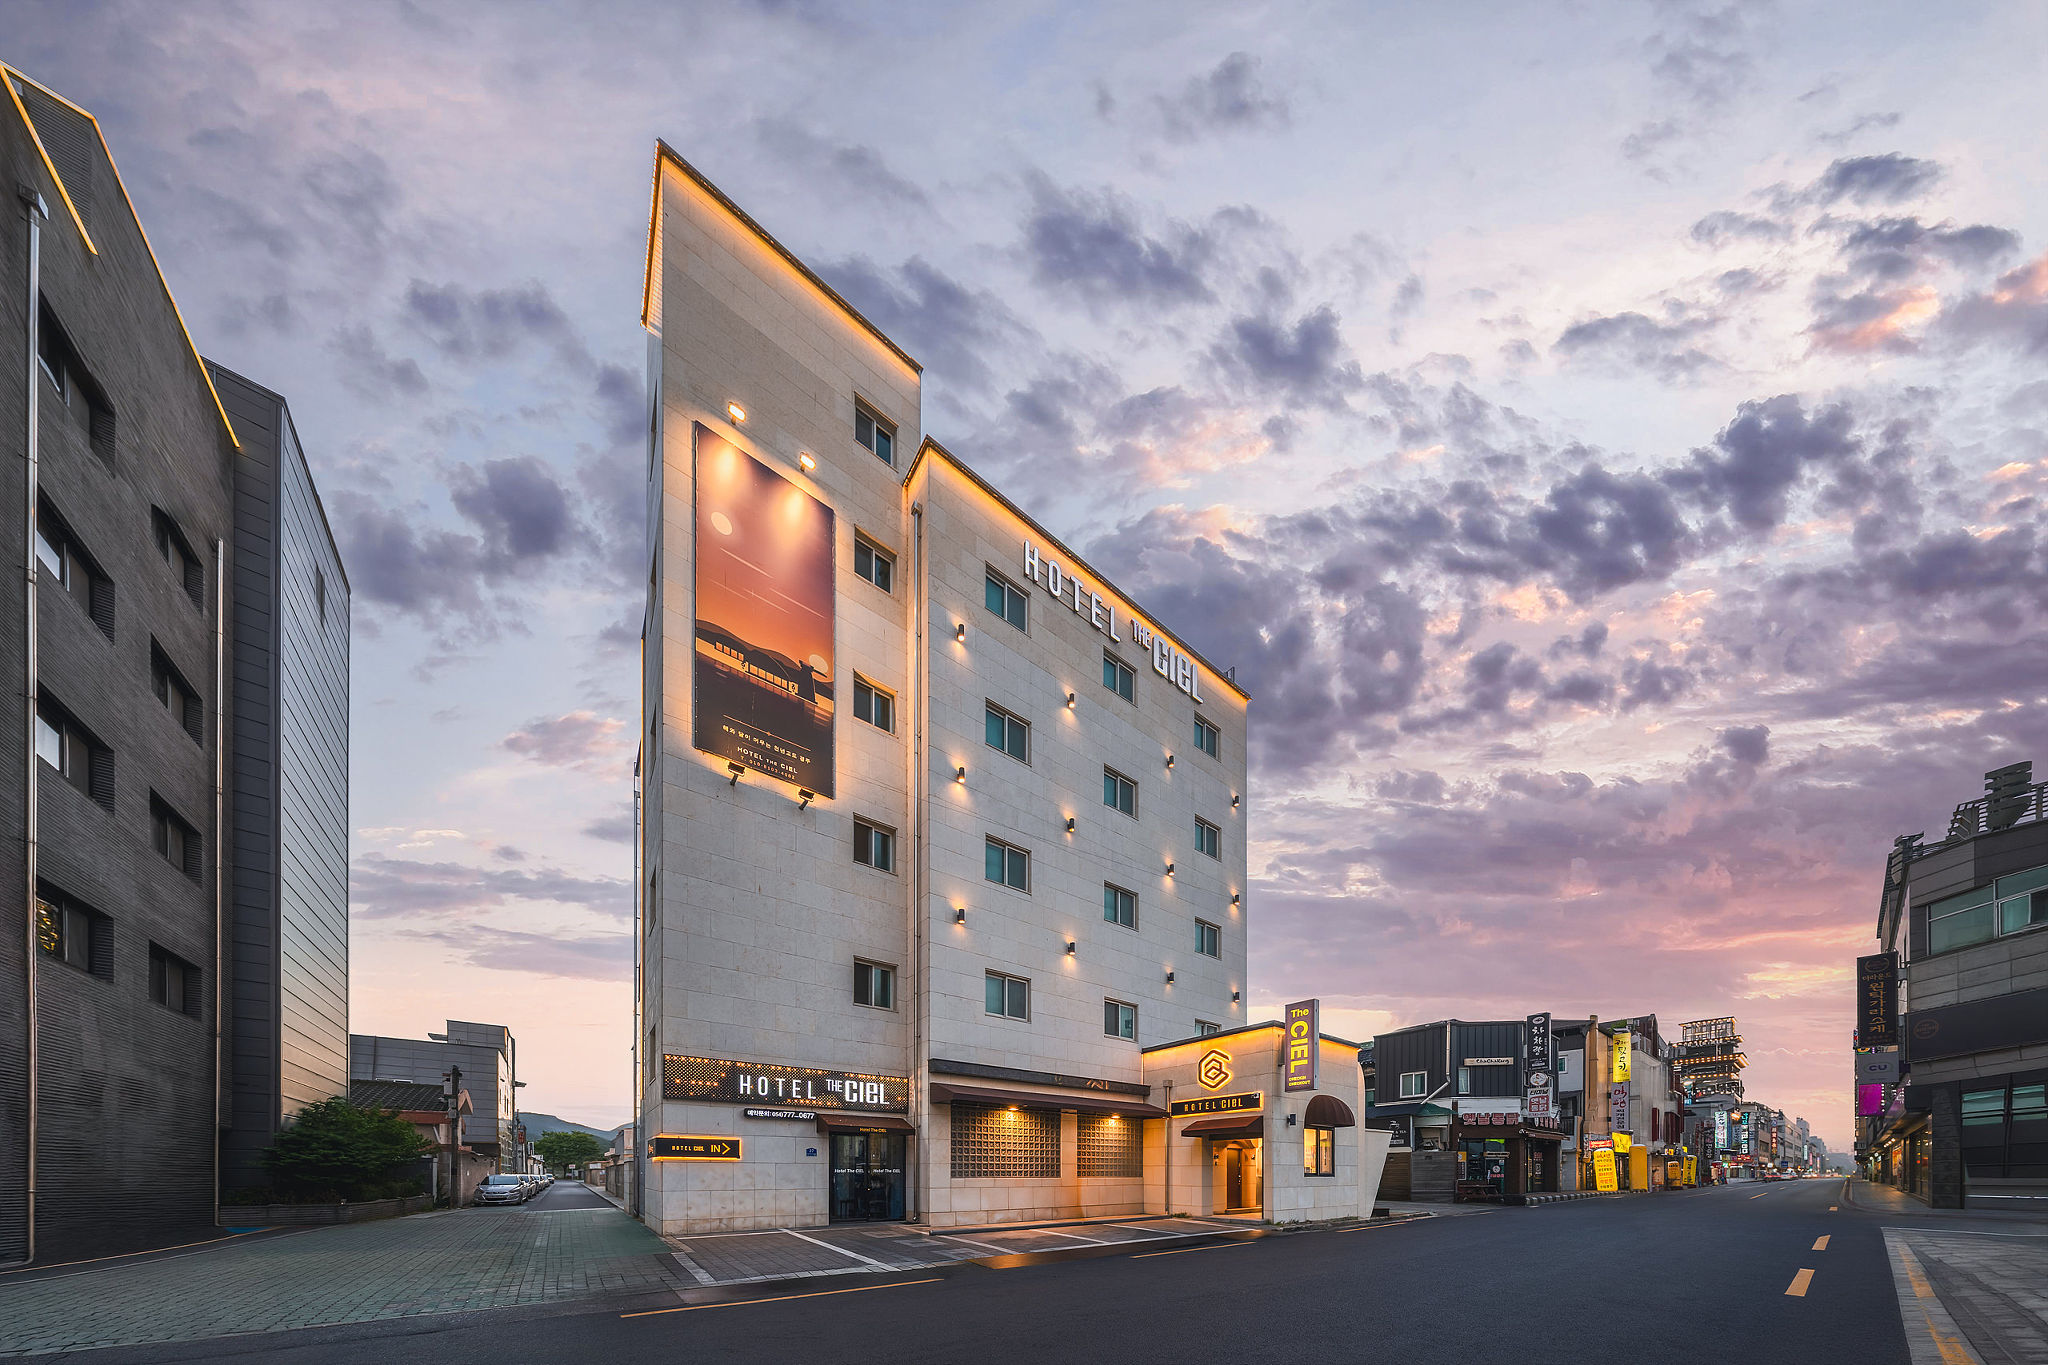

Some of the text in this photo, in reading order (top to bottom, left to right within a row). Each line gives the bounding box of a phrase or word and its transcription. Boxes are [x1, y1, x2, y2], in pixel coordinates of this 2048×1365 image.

[1024, 539, 1204, 705] HOTEL THE CIEL
[737, 746, 798, 774] HOTEL THE CIEL
[1290, 1008, 1310, 1019] The
[1290, 1020, 1309, 1074] CIEL
[1869, 1064, 1888, 1072] CU
[738, 1074, 891, 1105] HOTEL THE CIEL
[1184, 1101, 1217, 1112] HOTEL
[710, 1144, 721, 1153] IN
